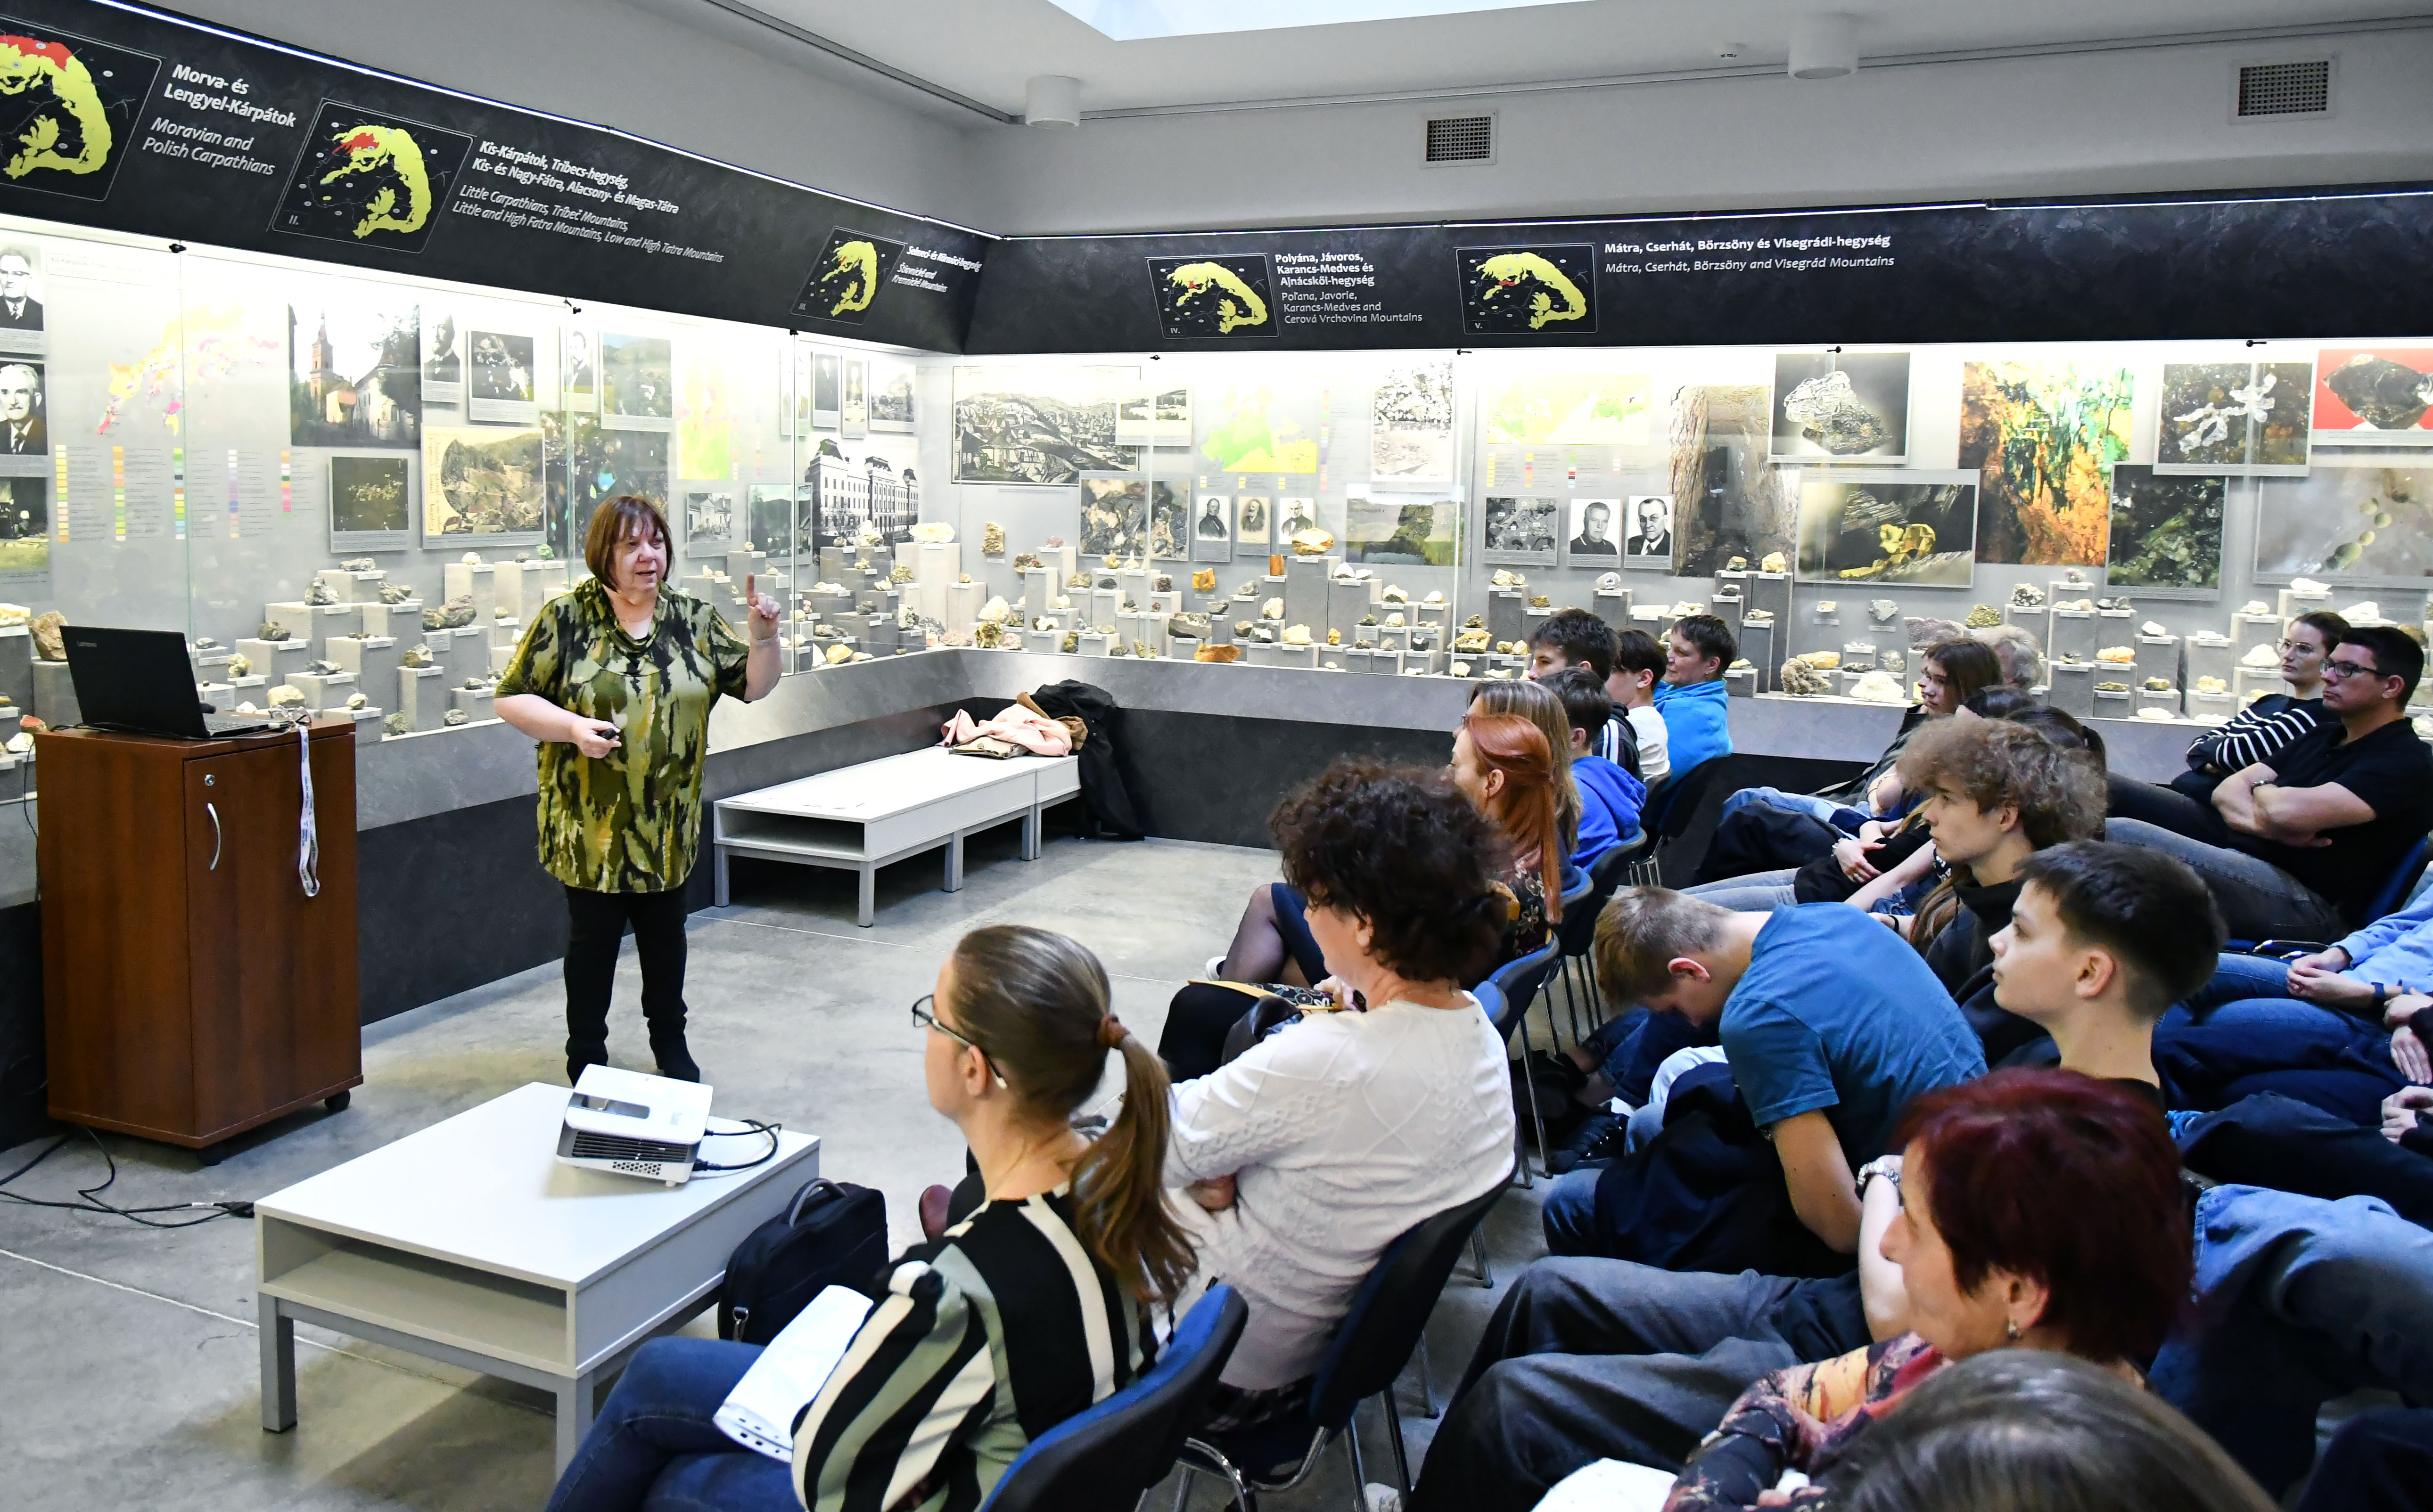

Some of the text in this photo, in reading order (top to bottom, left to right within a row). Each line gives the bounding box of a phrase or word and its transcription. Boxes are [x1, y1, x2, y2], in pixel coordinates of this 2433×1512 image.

[172, 64, 249, 94] Morva- és
[164, 83, 296, 127] Lengyel-Kárpátok
[150, 117, 255, 150] Moravian and
[142, 137, 275, 175] Polish Carpathians
[479, 141, 548, 170] Kis-Kárpátok,
[472, 157, 679, 214] Kis- és Nagy-Fátra, Alacsony- és Magas-Tátra
[460, 185, 489, 200] Little
[490, 191, 549, 215] Carpathians,
[580, 212, 628, 232] Mountains,
[452, 201, 724, 262] Little and High Fatra Mountains, Low and High Tatra Mountains
[1604, 235, 1891, 254] Mátra, Cserhát, Börzsöny és Visegrádi-hegység
[930, 251, 938, 260] és
[1275, 253, 1363, 264] Polyána, Jávoros,
[1277, 262, 1374, 274] Karancs-Medves és
[1605, 256, 1895, 274] Mátra, Cserhát, Börzsöny and Visegrád Mountains
[924, 271, 937, 279] and
[920, 280, 948, 293] Mountains
[1320, 291, 1357, 301] Javorie,
[1284, 302, 1381, 312] Karancs-Medves and
[1284, 313, 1422, 324] Cerová Vrchovina Mountains
